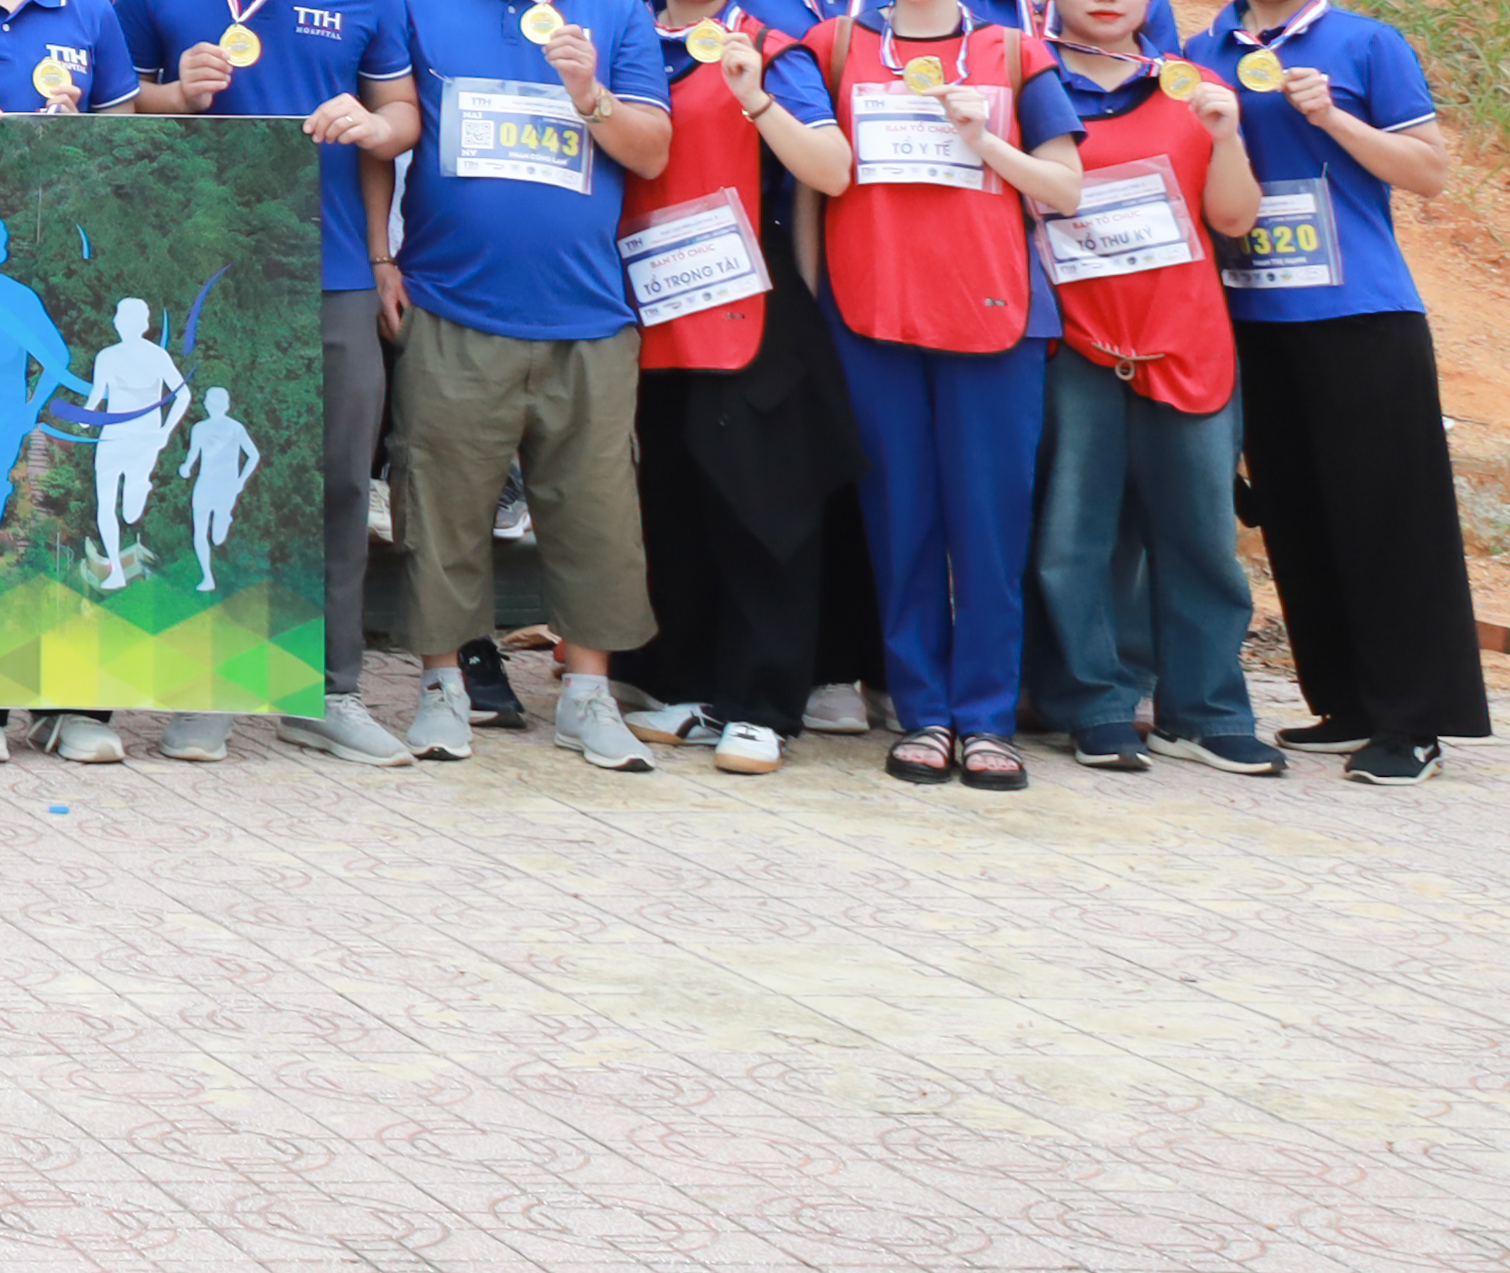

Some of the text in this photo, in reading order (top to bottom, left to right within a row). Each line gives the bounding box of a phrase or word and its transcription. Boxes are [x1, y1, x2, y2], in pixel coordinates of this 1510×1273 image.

[294, 7, 341, 30] TTH
[296, 27, 341, 40] HOSPITAL
[45, 44, 87, 66] TTH
[498, 122, 580, 157] 0443
[892, 135, 953, 156] TỔ Y TẾ
[1076, 234, 1096, 251] TỔ
[1098, 230, 1130, 247] THƯ
[650, 257, 670, 269] BAN
[643, 257, 740, 296] TỔ TRỌNG TÀI
